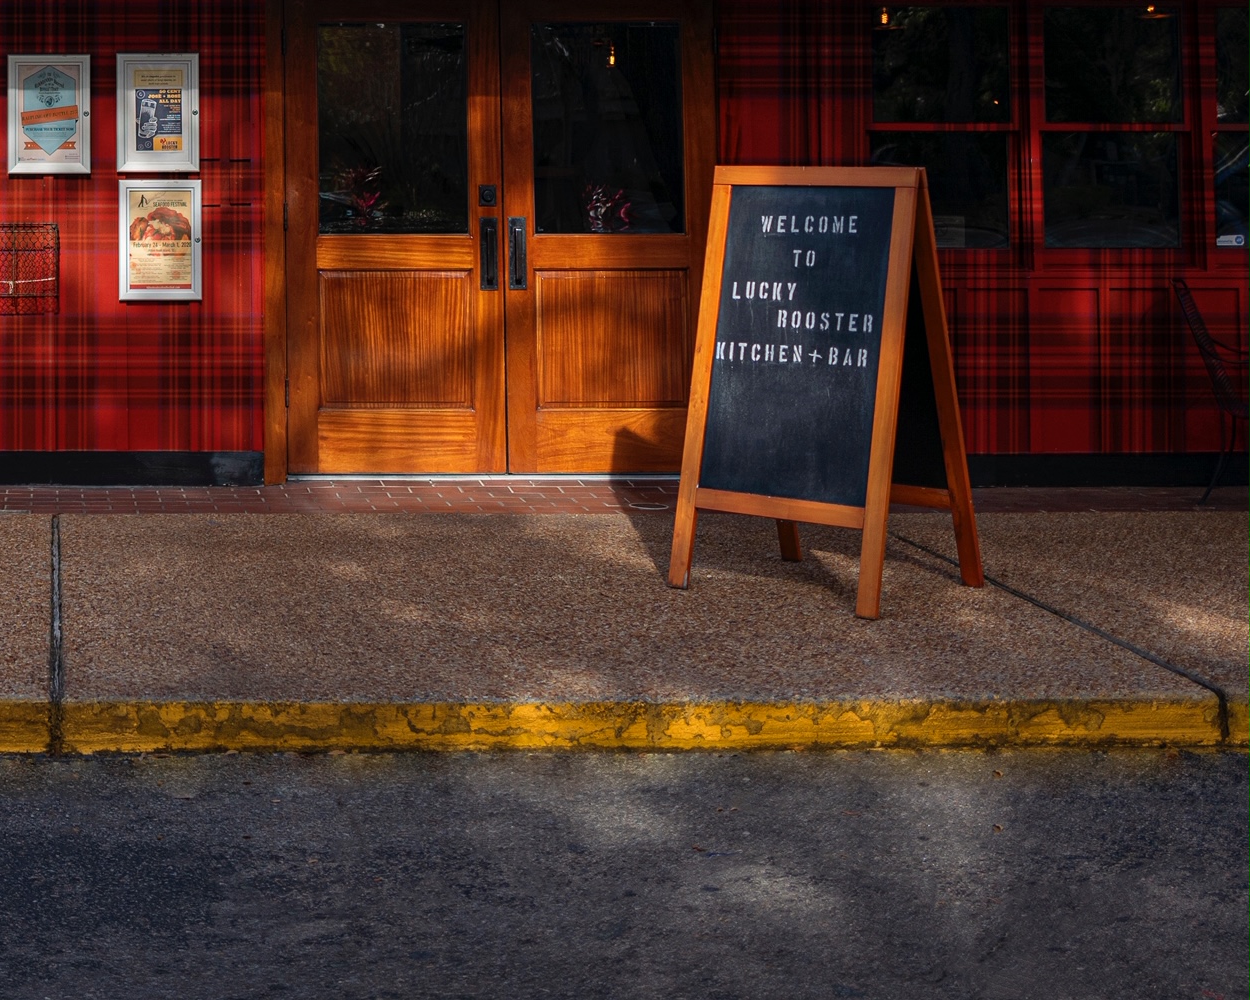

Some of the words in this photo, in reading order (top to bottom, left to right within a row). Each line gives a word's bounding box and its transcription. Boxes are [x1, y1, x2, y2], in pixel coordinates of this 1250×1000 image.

[761, 215, 859, 234] WELCOME
[793, 249, 816, 267] TO
[731, 281, 798, 302] LUCKY
[776, 309, 874, 333] ROOSTER
